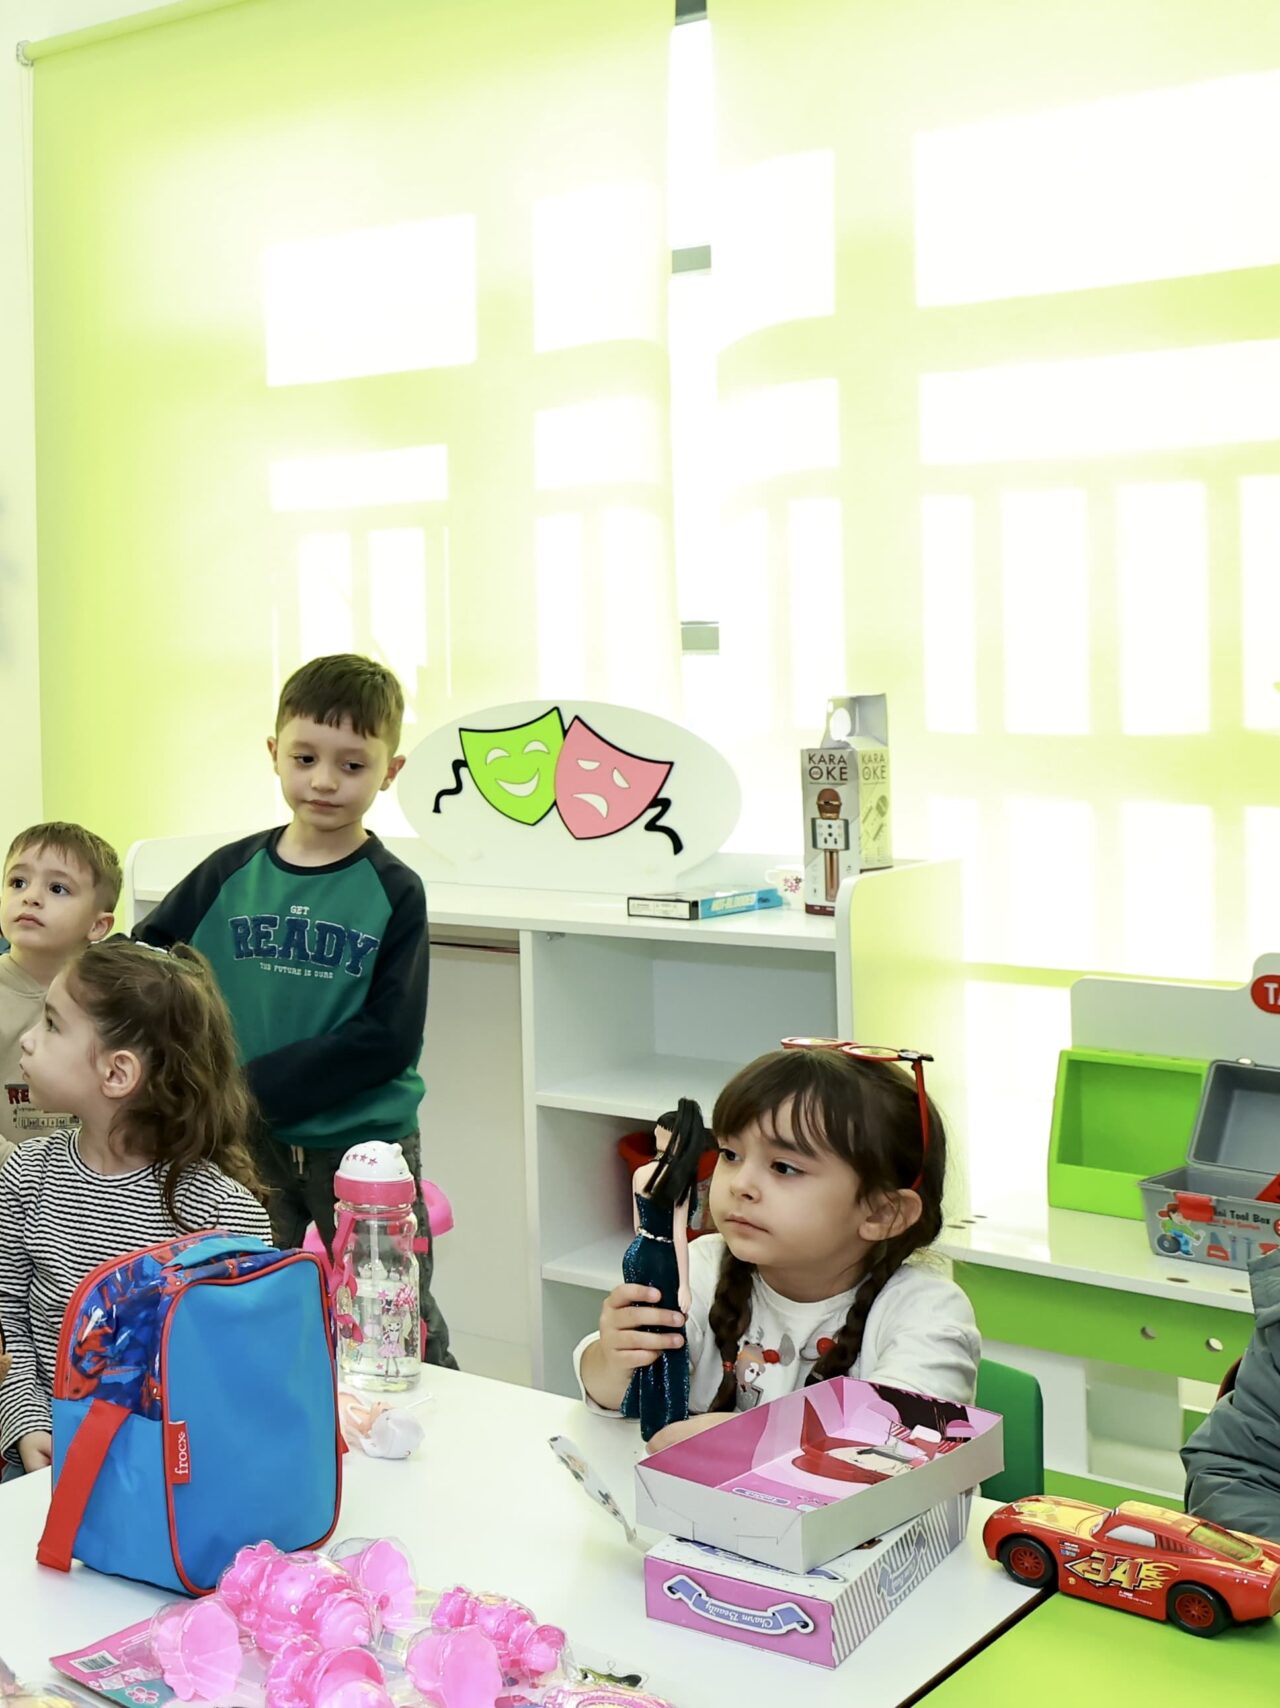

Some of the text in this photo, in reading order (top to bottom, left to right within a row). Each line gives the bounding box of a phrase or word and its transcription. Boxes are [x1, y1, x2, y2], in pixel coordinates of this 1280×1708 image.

[808, 753, 848, 765] KARA
[861, 752, 886, 764] KARA
[808, 765, 849, 781] OKE
[862, 765, 887, 780] OKE
[290, 905, 310, 916] GET
[228, 914, 380, 978] READY
[274, 965, 302, 977] FUTURE
[705, 1600, 773, 1628] Charm Beauty
